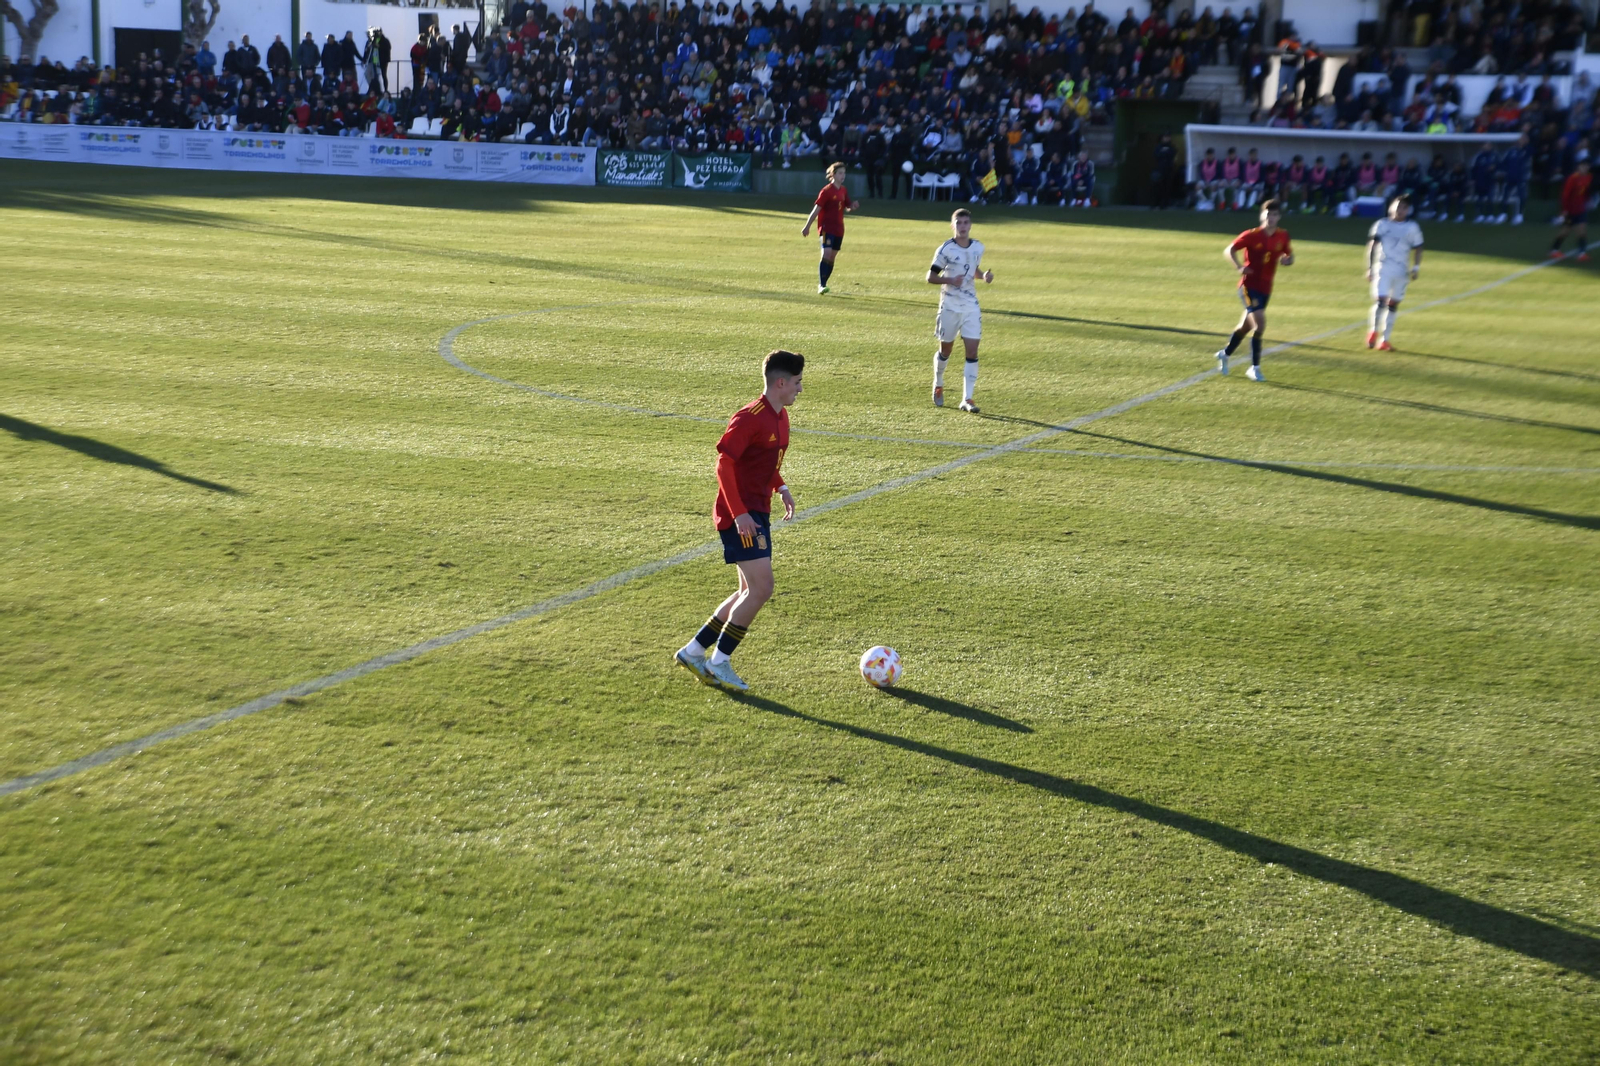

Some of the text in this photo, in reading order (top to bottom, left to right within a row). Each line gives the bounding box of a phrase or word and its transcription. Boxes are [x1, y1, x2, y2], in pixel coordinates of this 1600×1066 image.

[81, 144, 142, 153] TORREMOLINOS
[223, 150, 286, 160] TORREMOLINOS
[634, 154, 661, 162] FRUTAS
[369, 157, 433, 167] TORREMOLINOS
[706, 156, 734, 165] HOTEL
[520, 164, 584, 173] TORREMOLINOS
[695, 164, 744, 174] PEZ ESPADA
[604, 167, 665, 181] Manantiales
[963, 263, 970, 277] 9
[776, 447, 784, 469] 8
